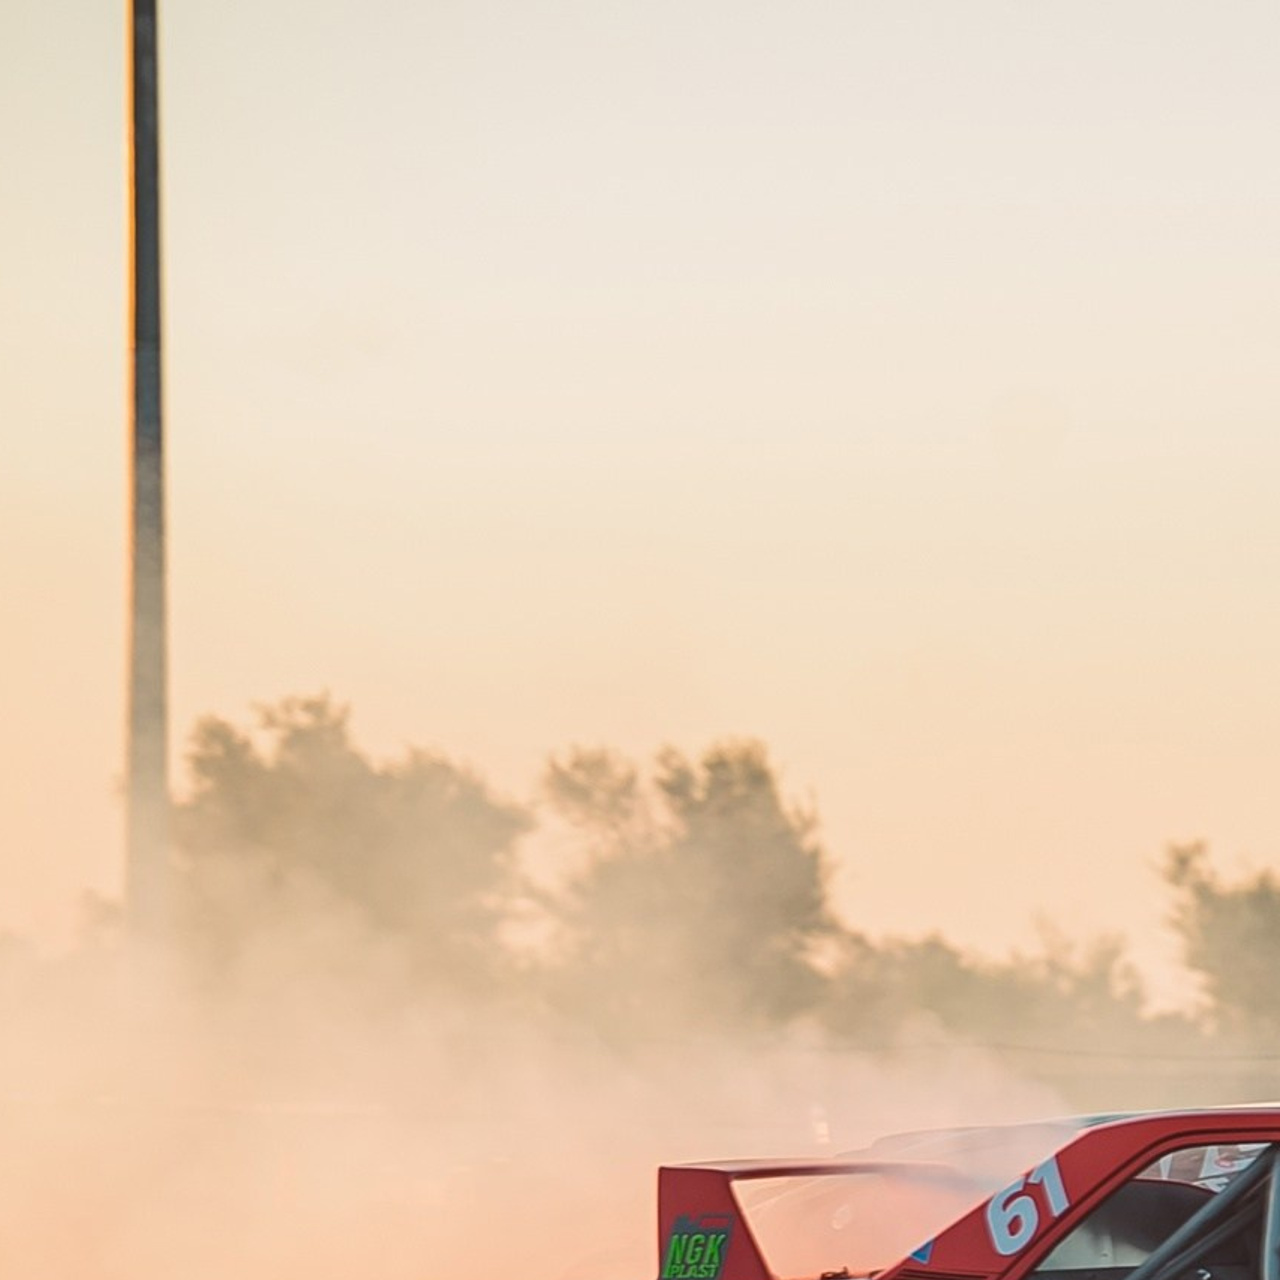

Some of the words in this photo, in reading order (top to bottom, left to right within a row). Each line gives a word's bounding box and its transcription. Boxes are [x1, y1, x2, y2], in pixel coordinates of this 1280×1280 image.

[987, 1157, 1070, 1255] 61
[667, 1234, 726, 1265] NGK
[669, 1264, 718, 1279] PLAST
